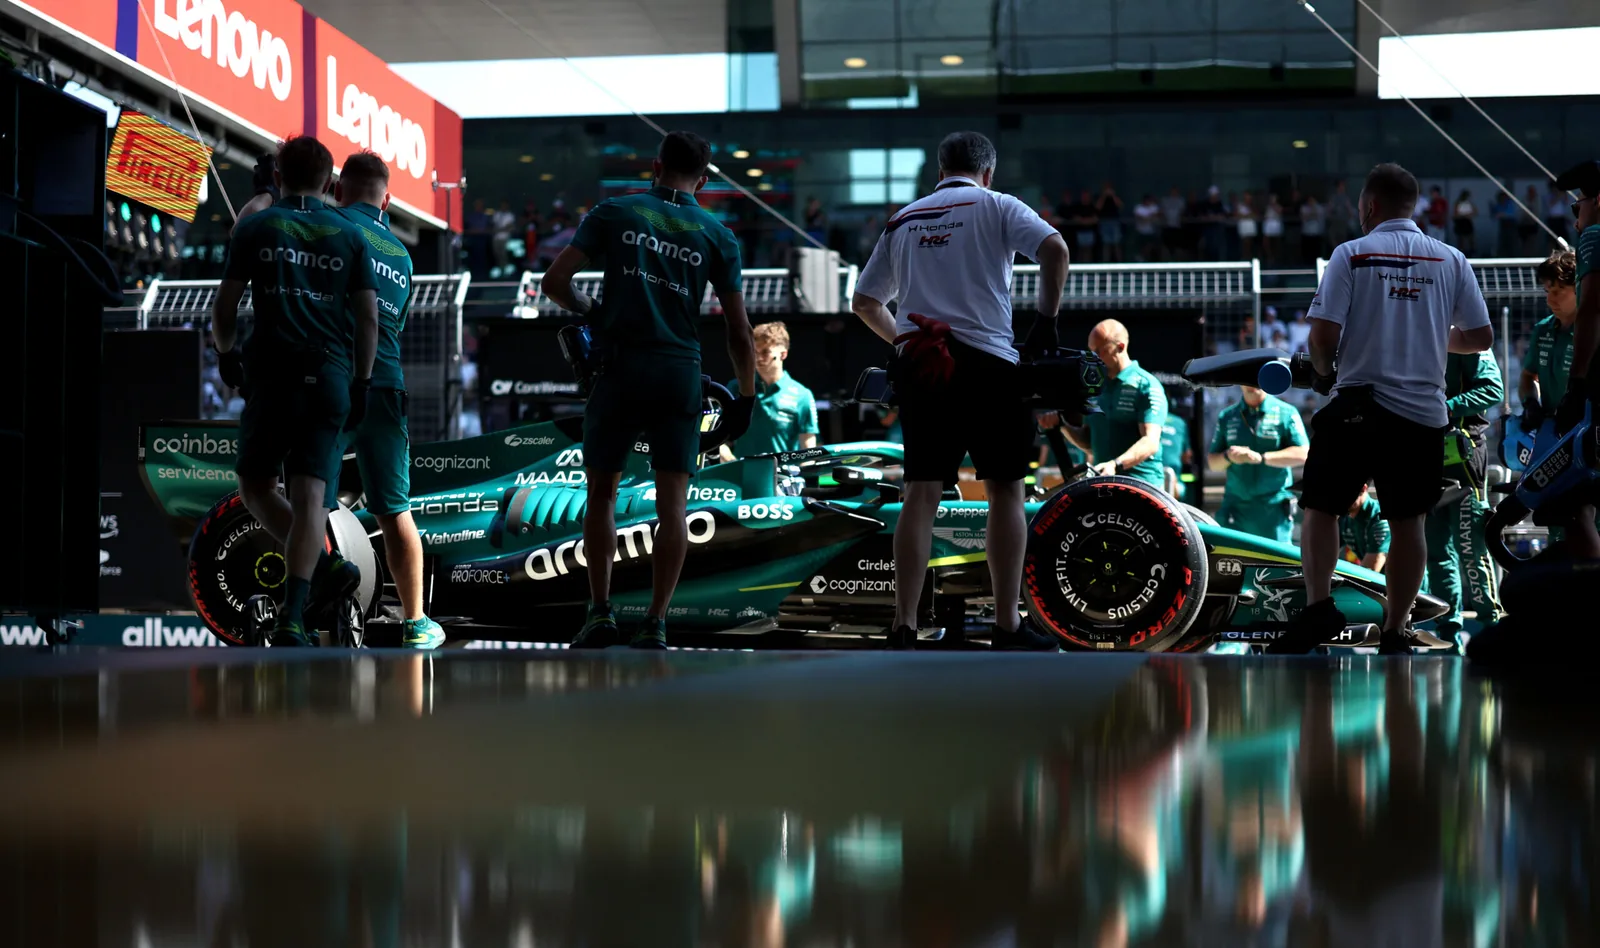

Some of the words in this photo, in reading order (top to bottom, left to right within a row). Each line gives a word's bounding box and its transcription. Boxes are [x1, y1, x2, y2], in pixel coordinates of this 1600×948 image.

[154, 0, 292, 101] Lenovo
[326, 55, 427, 179] Lenovo
[117, 130, 202, 200] PIRELLI
[919, 222, 963, 232] Honda
[621, 230, 703, 267] aramco
[919, 233, 951, 246] HRC
[258, 247, 344, 272] aramco
[371, 257, 407, 289] mco
[638, 267, 689, 296] Honda
[1389, 274, 1433, 284] Honda
[279, 285, 334, 302] Honda
[1388, 287, 1421, 299] HRC
[376, 297, 399, 316] nda
[153, 433, 239, 455] coinbas
[522, 435, 555, 445] zscaler
[415, 455, 491, 472] cognizant
[790, 449, 823, 460] Cognition
[1542, 447, 1566, 471] EIGHT
[158, 465, 237, 480] serviceno
[1547, 453, 1570, 478] SLEEP
[514, 470, 588, 485] MAAD
[468, 491, 486, 501] by
[687, 484, 737, 502] here
[409, 499, 499, 515] Honda
[738, 503, 795, 521] BOSS
[950, 508, 989, 518] pepper
[223, 520, 266, 549] CELSIU
[1097, 513, 1154, 544] CELSIUS
[525, 511, 716, 581] armo
[451, 568, 511, 584] PROFORCE+
[1463, 558, 1485, 605] ASTON
[829, 577, 896, 594] cognizant
[1107, 579, 1159, 620] CELSIUS
[708, 608, 731, 616] HRC
[1128, 587, 1187, 647] ZERO
[1250, 607, 1261, 616] 18
